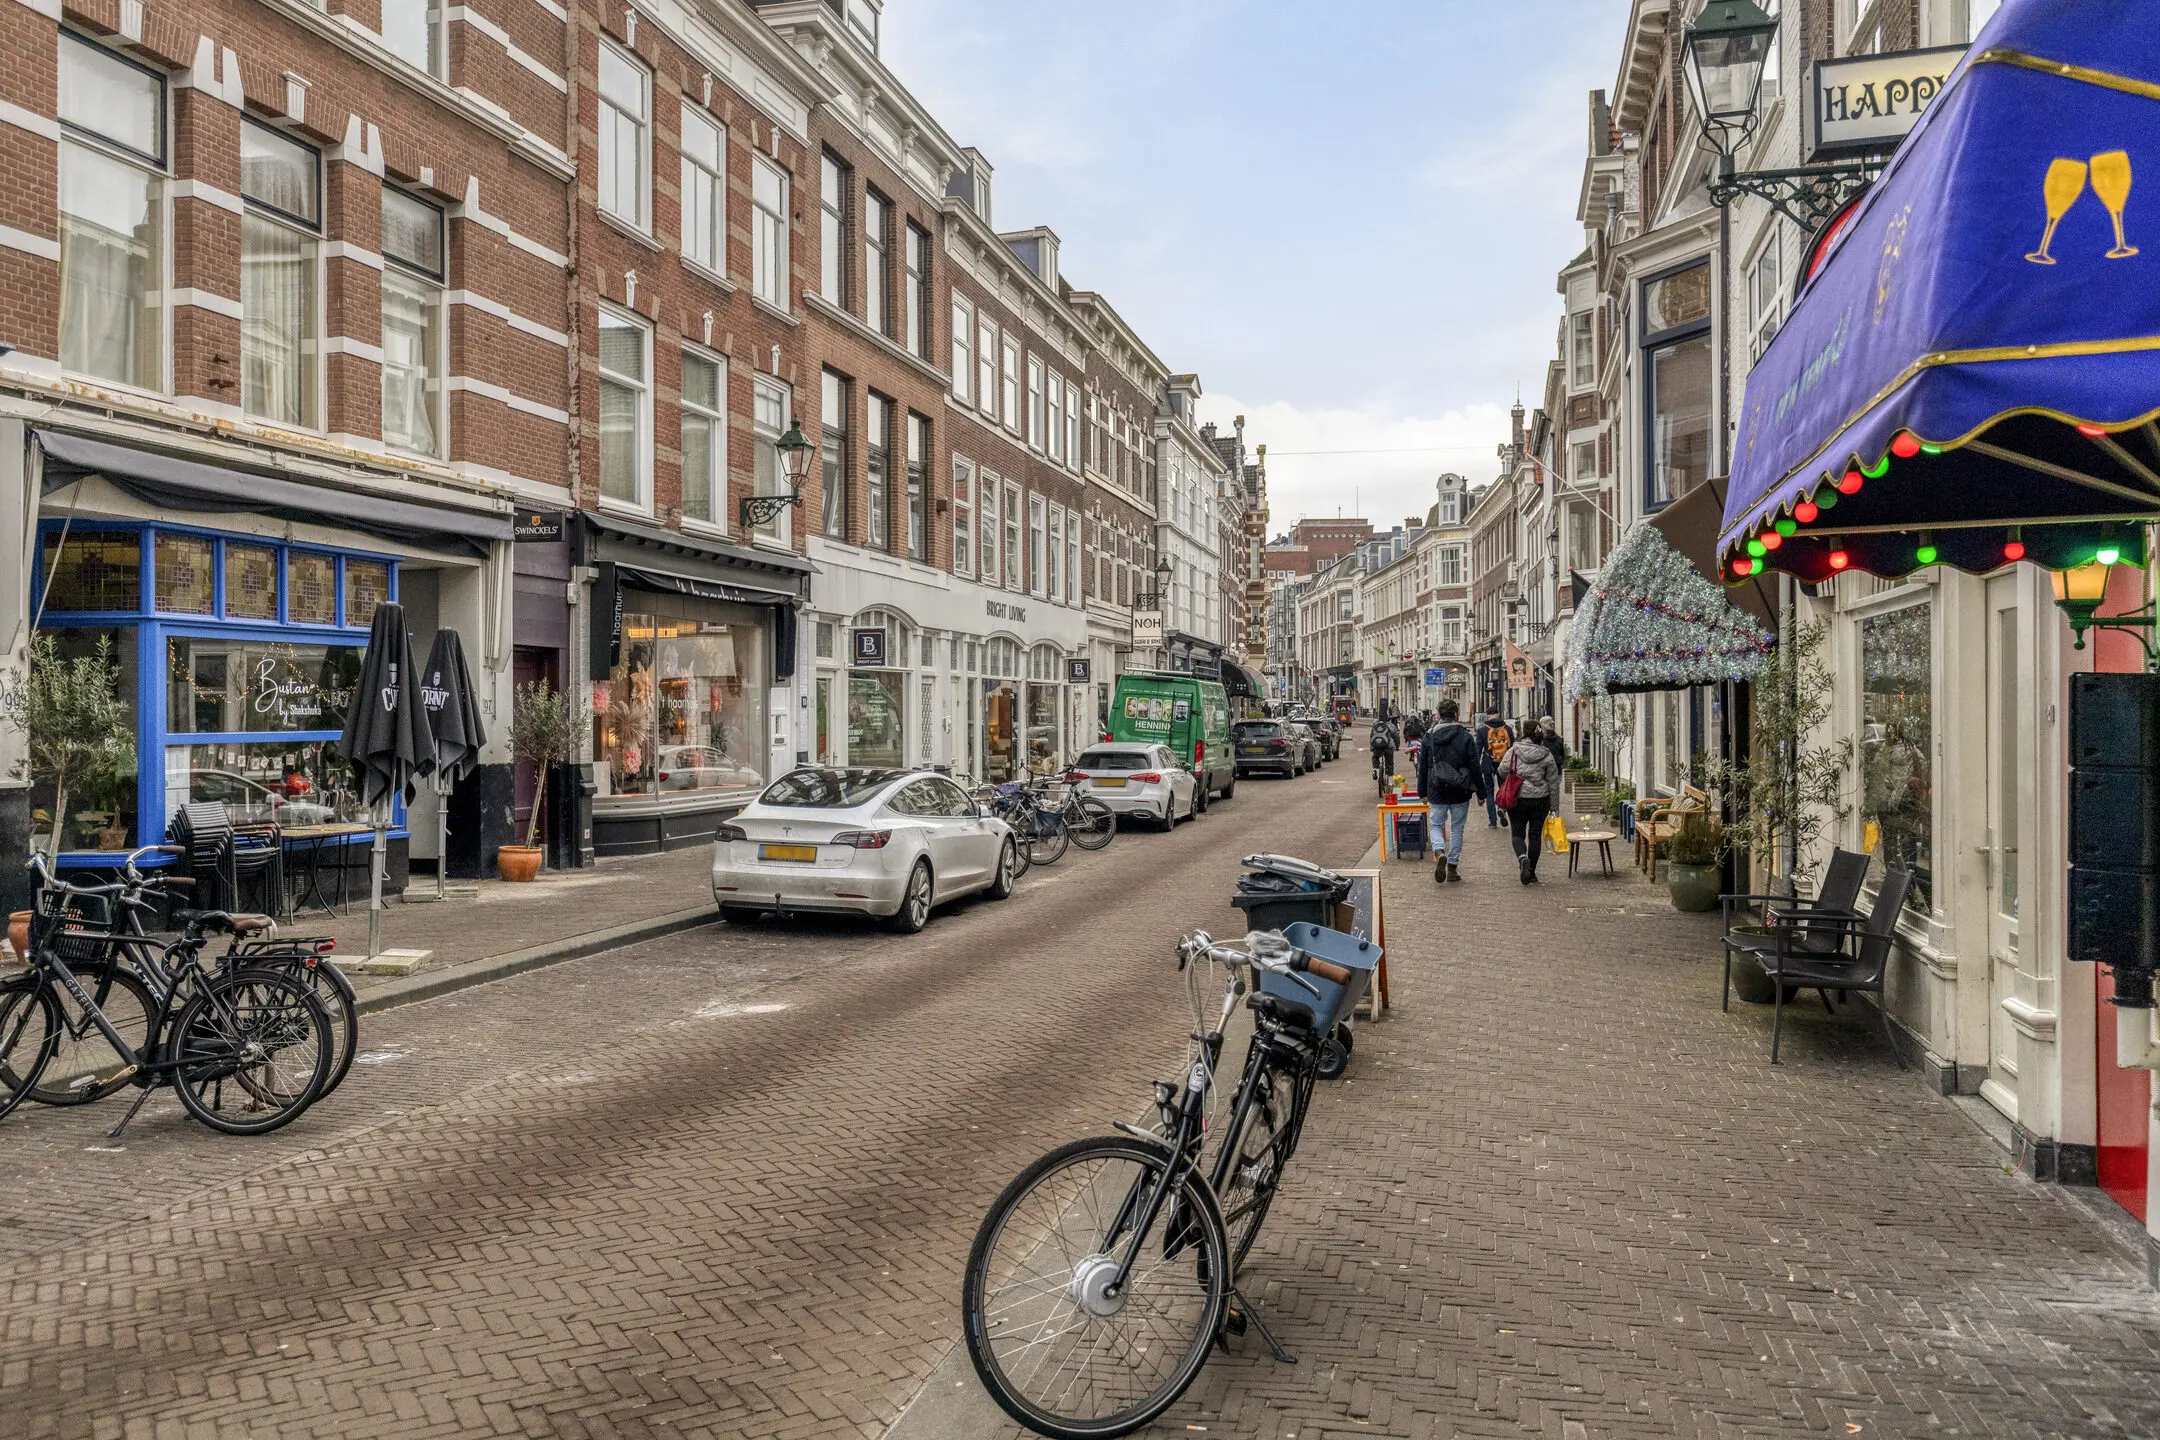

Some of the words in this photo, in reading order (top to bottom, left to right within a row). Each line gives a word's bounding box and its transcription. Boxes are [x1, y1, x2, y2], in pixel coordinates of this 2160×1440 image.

[612, 591, 623, 636] haarhuis
[986, 599, 1007, 620] BRIGHT
[1008, 604, 1026, 623] LIVING
[1134, 617, 1161, 629] NOH
[254, 658, 311, 713] Bustan
[279, 698, 290, 726] by
[290, 704, 322, 716] Shakshuka
[65, 978, 100, 1020] GAZELLE
